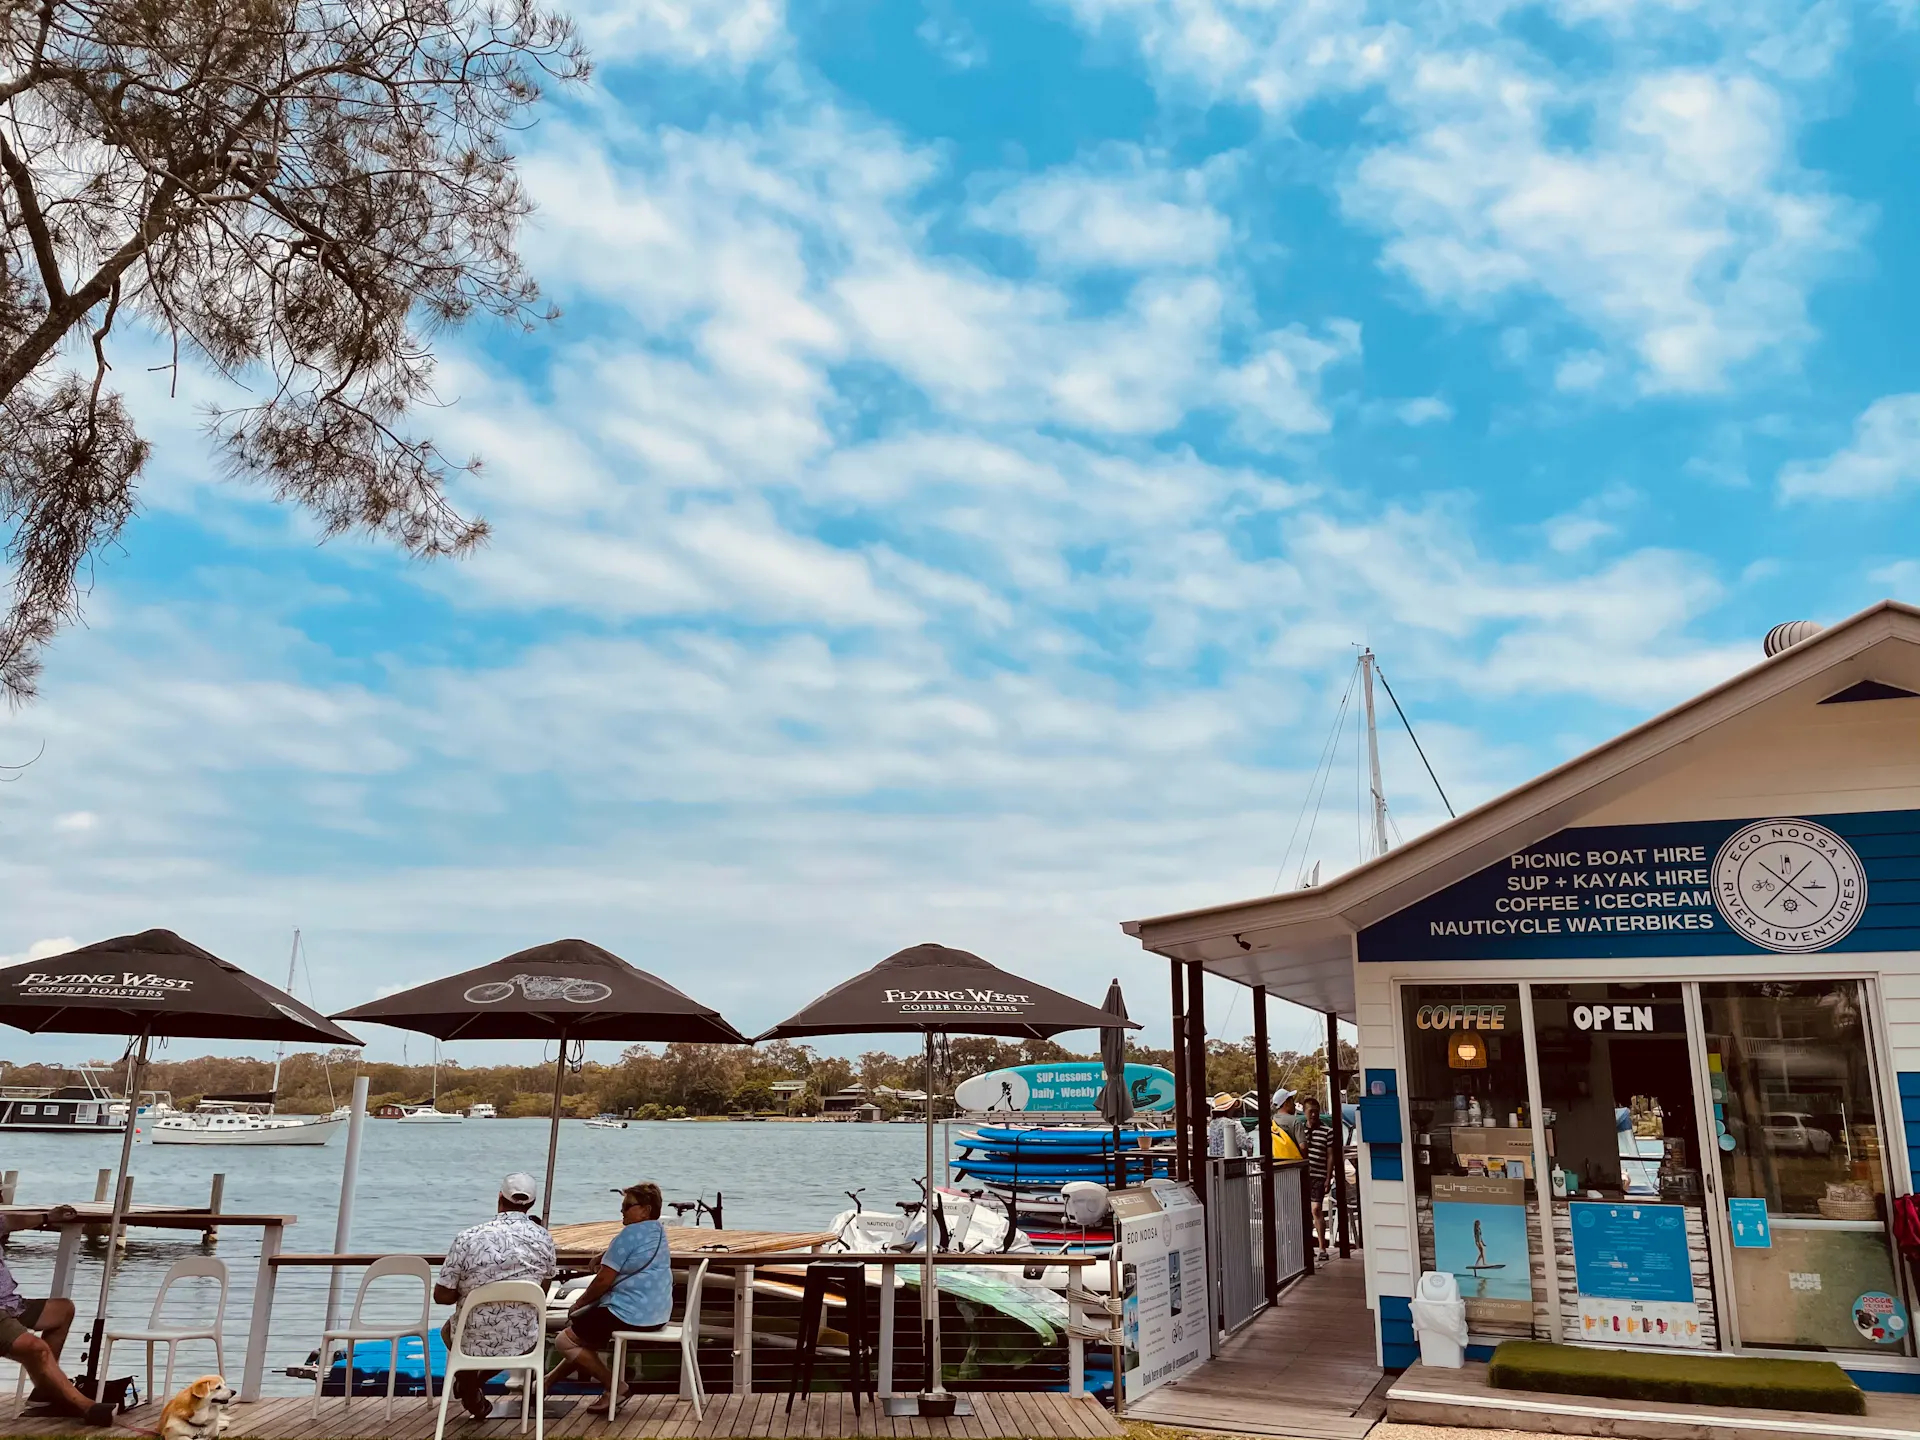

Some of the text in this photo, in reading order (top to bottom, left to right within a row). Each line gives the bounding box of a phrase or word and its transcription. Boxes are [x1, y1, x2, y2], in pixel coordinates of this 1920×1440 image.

[1730, 828, 1838, 862] ECO NOOSA
[1511, 846, 1706, 869] PICNIC BOAT HIRE
[1507, 869, 1709, 891] SUP + KAYAK HIRE
[1495, 895, 1579, 912] COFFEE
[1595, 891, 1711, 909] ICECREAM
[1723, 878, 1855, 942] RIVER ADVENTURES
[1430, 913, 1714, 936] NAUTICYCLE WATERBIKES
[18, 972, 194, 989] FLYING WEST
[27, 986, 163, 997] COFFEE ROASTERS
[884, 988, 1030, 1003] FLYING WEST
[954, 1004, 1018, 1012] ROASTERS
[1416, 1005, 1507, 1030] COFFEE
[1573, 1005, 1654, 1031] OPEN
[1036, 1072, 1054, 1083] SUP
[1055, 1072, 1092, 1082] Lessons
[1032, 1088, 1055, 1099] Daily
[1061, 1087, 1095, 1098] Weekly
[1127, 1227, 1158, 1244] ECO NOOSA
[1790, 1281, 1821, 1290] POPS
